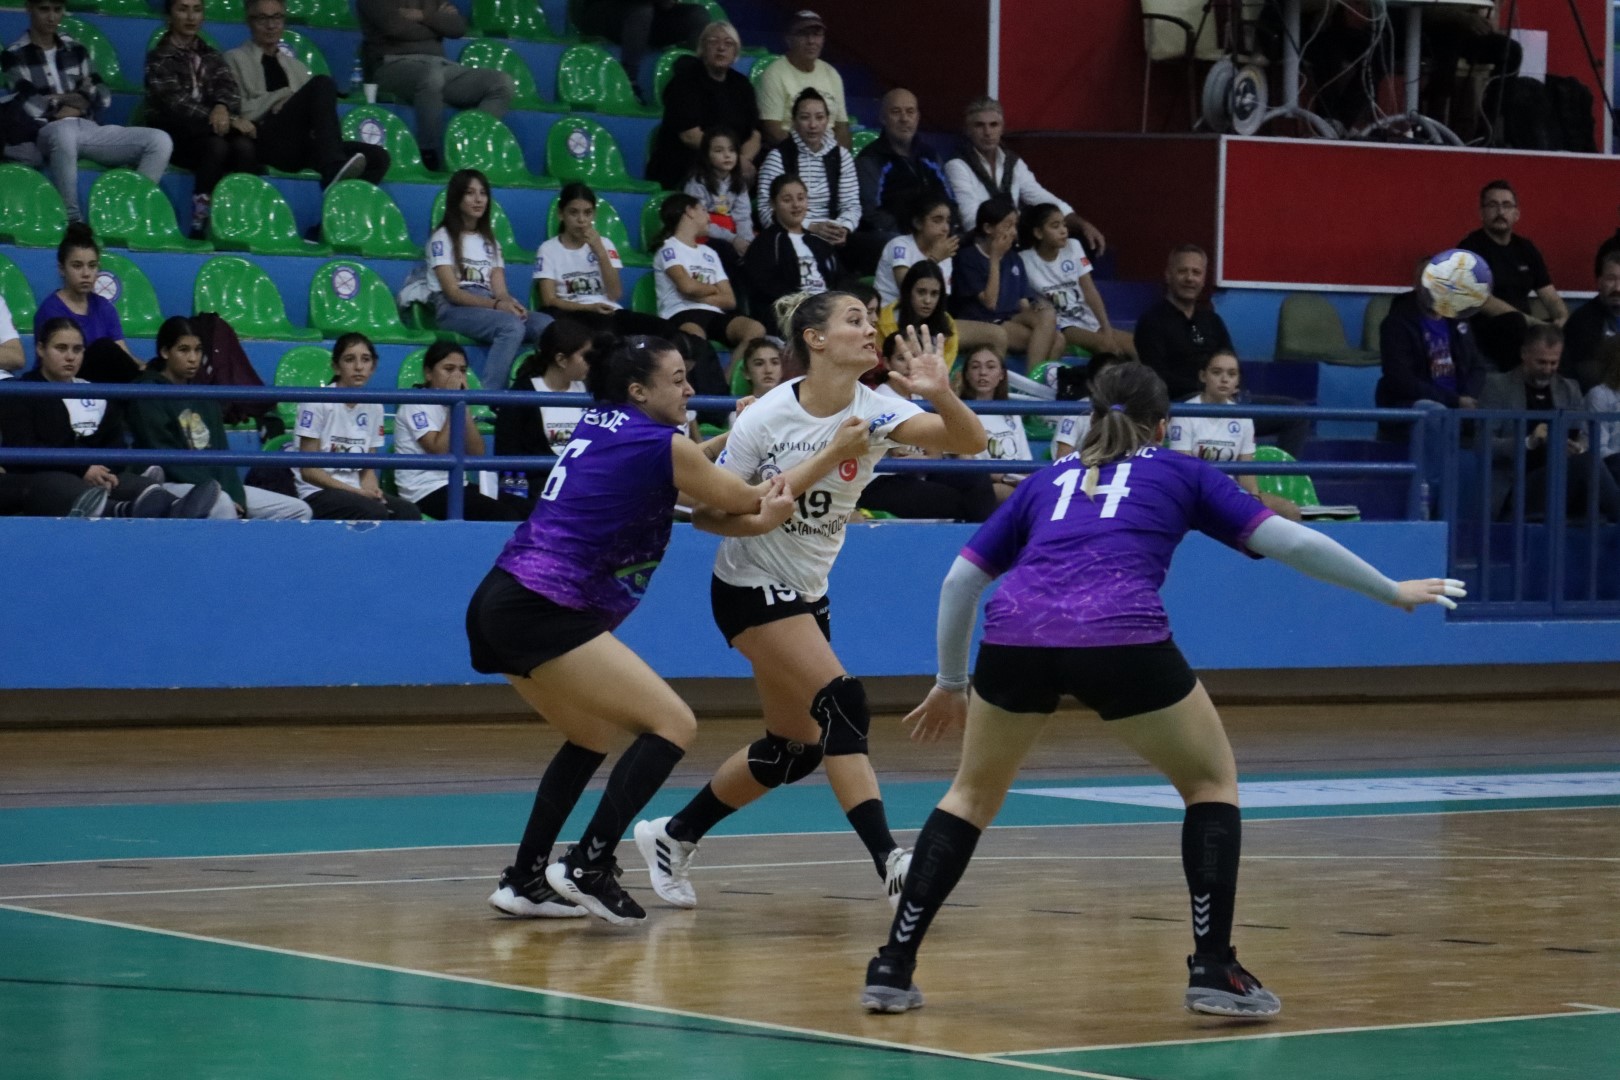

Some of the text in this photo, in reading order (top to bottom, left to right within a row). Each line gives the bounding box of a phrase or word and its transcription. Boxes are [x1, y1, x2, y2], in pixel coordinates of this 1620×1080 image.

[541, 438, 593, 501] 6
[1051, 462, 1132, 521] 14
[794, 490, 833, 520] 19
